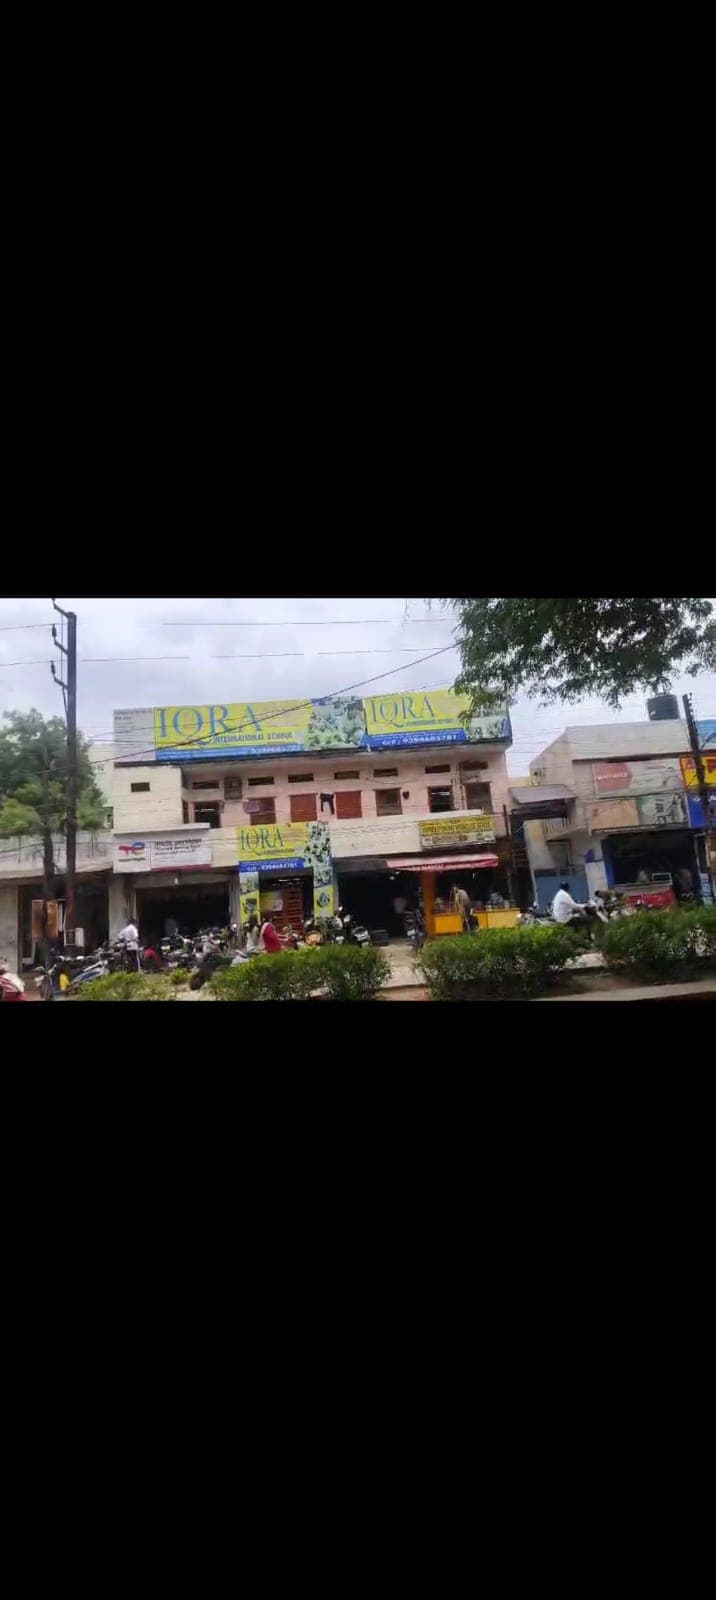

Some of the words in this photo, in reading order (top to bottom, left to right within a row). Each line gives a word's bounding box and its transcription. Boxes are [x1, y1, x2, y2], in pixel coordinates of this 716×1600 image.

[155, 704, 263, 746] IQRA
[369, 695, 435, 727] IQRA
[240, 826, 285, 856] IQRA
